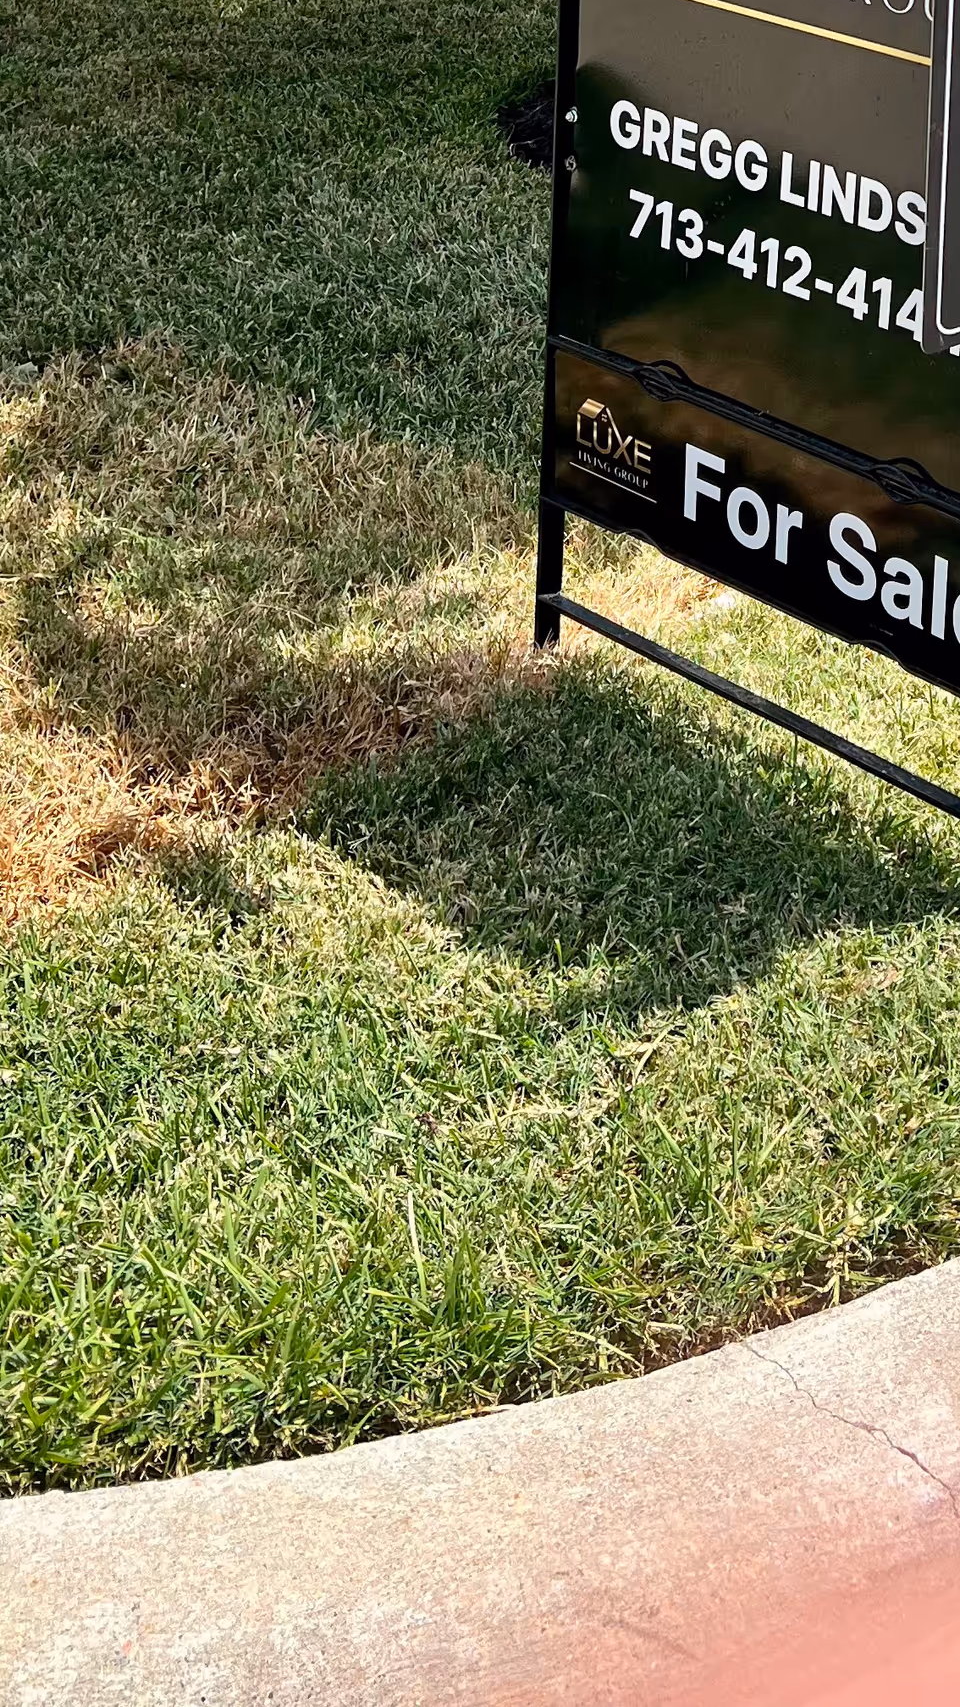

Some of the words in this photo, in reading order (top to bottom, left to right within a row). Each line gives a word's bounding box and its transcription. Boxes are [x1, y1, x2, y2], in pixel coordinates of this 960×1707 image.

[610, 100, 768, 191] GREGG
[577, 407, 652, 474] LUXE
[579, 450, 611, 473] LIVING
[614, 467, 649, 489] GROUP
[683, 443, 802, 565] For
